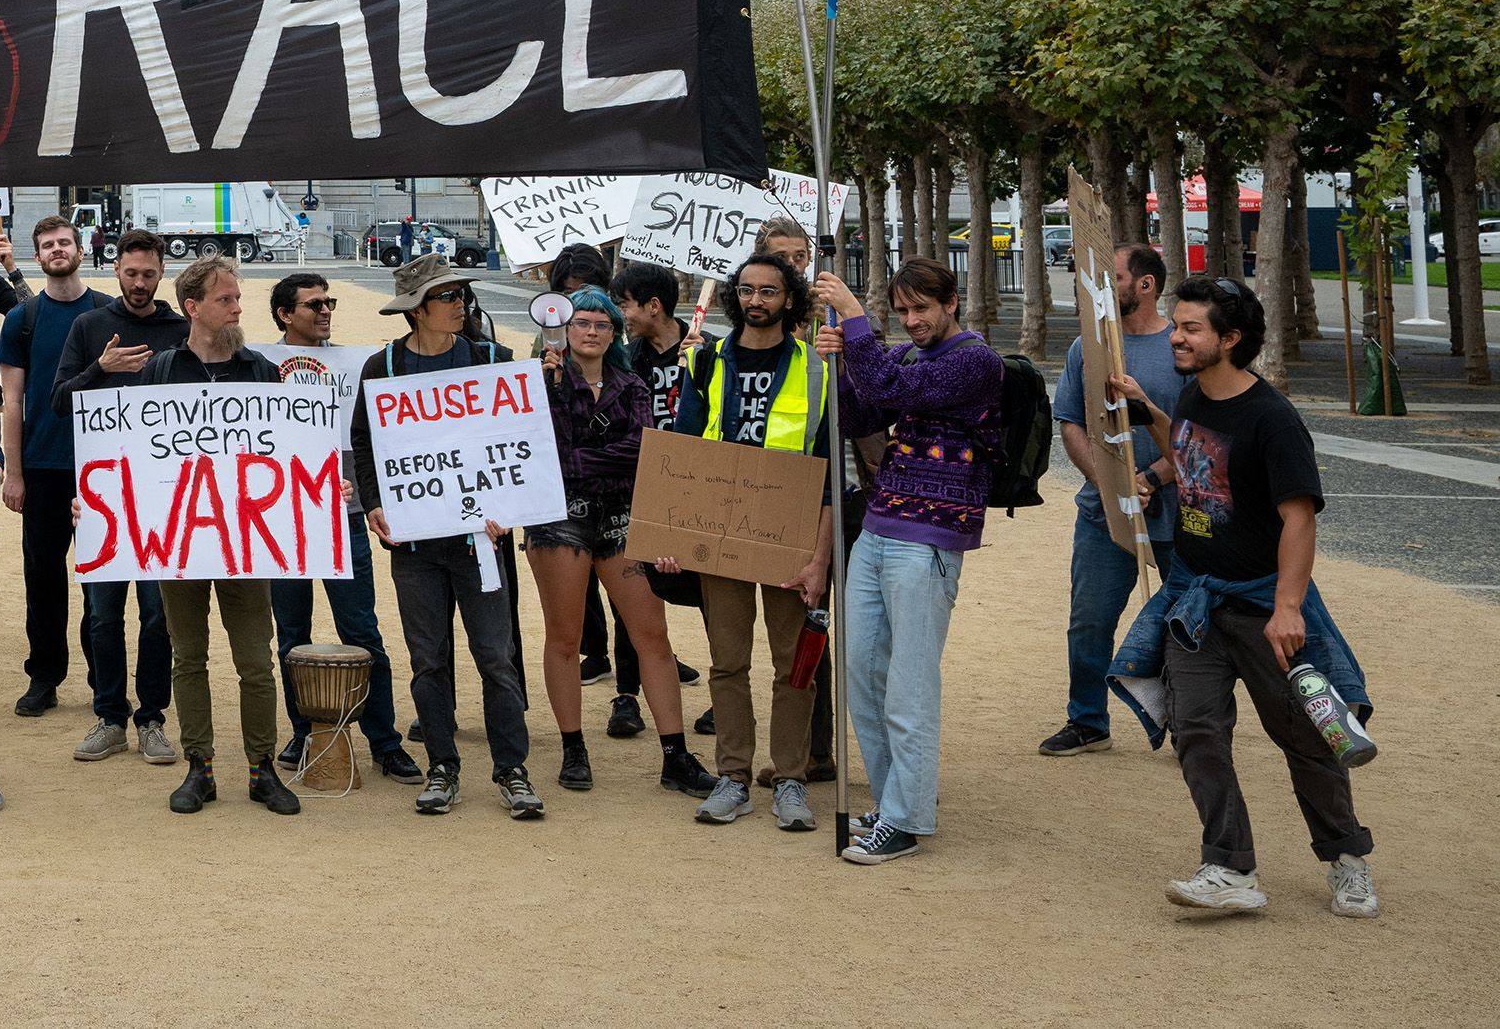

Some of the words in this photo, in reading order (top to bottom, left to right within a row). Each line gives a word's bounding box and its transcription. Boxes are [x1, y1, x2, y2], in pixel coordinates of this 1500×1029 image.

[673, 172, 745, 195] NOUGH
[514, 197, 599, 232] RUNS
[534, 214, 629, 251] FAIL
[644, 191, 764, 249] SATISF
[687, 245, 731, 274] PAUSE
[375, 380, 484, 427] PAUSE
[492, 373, 533, 417] AI
[739, 372, 775, 394] TO
[75, 390, 133, 434] task
[141, 387, 340, 429] environment
[739, 396, 768, 419] HE
[150, 426, 275, 459] seems
[737, 421, 765, 442] AC
[385, 449, 464, 477] BEFORE
[486, 441, 532, 464] IT'S
[390, 478, 444, 502] TOO
[458, 464, 525, 493] LATE
[75, 445, 345, 578] SWARM
[668, 506, 726, 536] Fucking
[736, 514, 786, 542] Around
